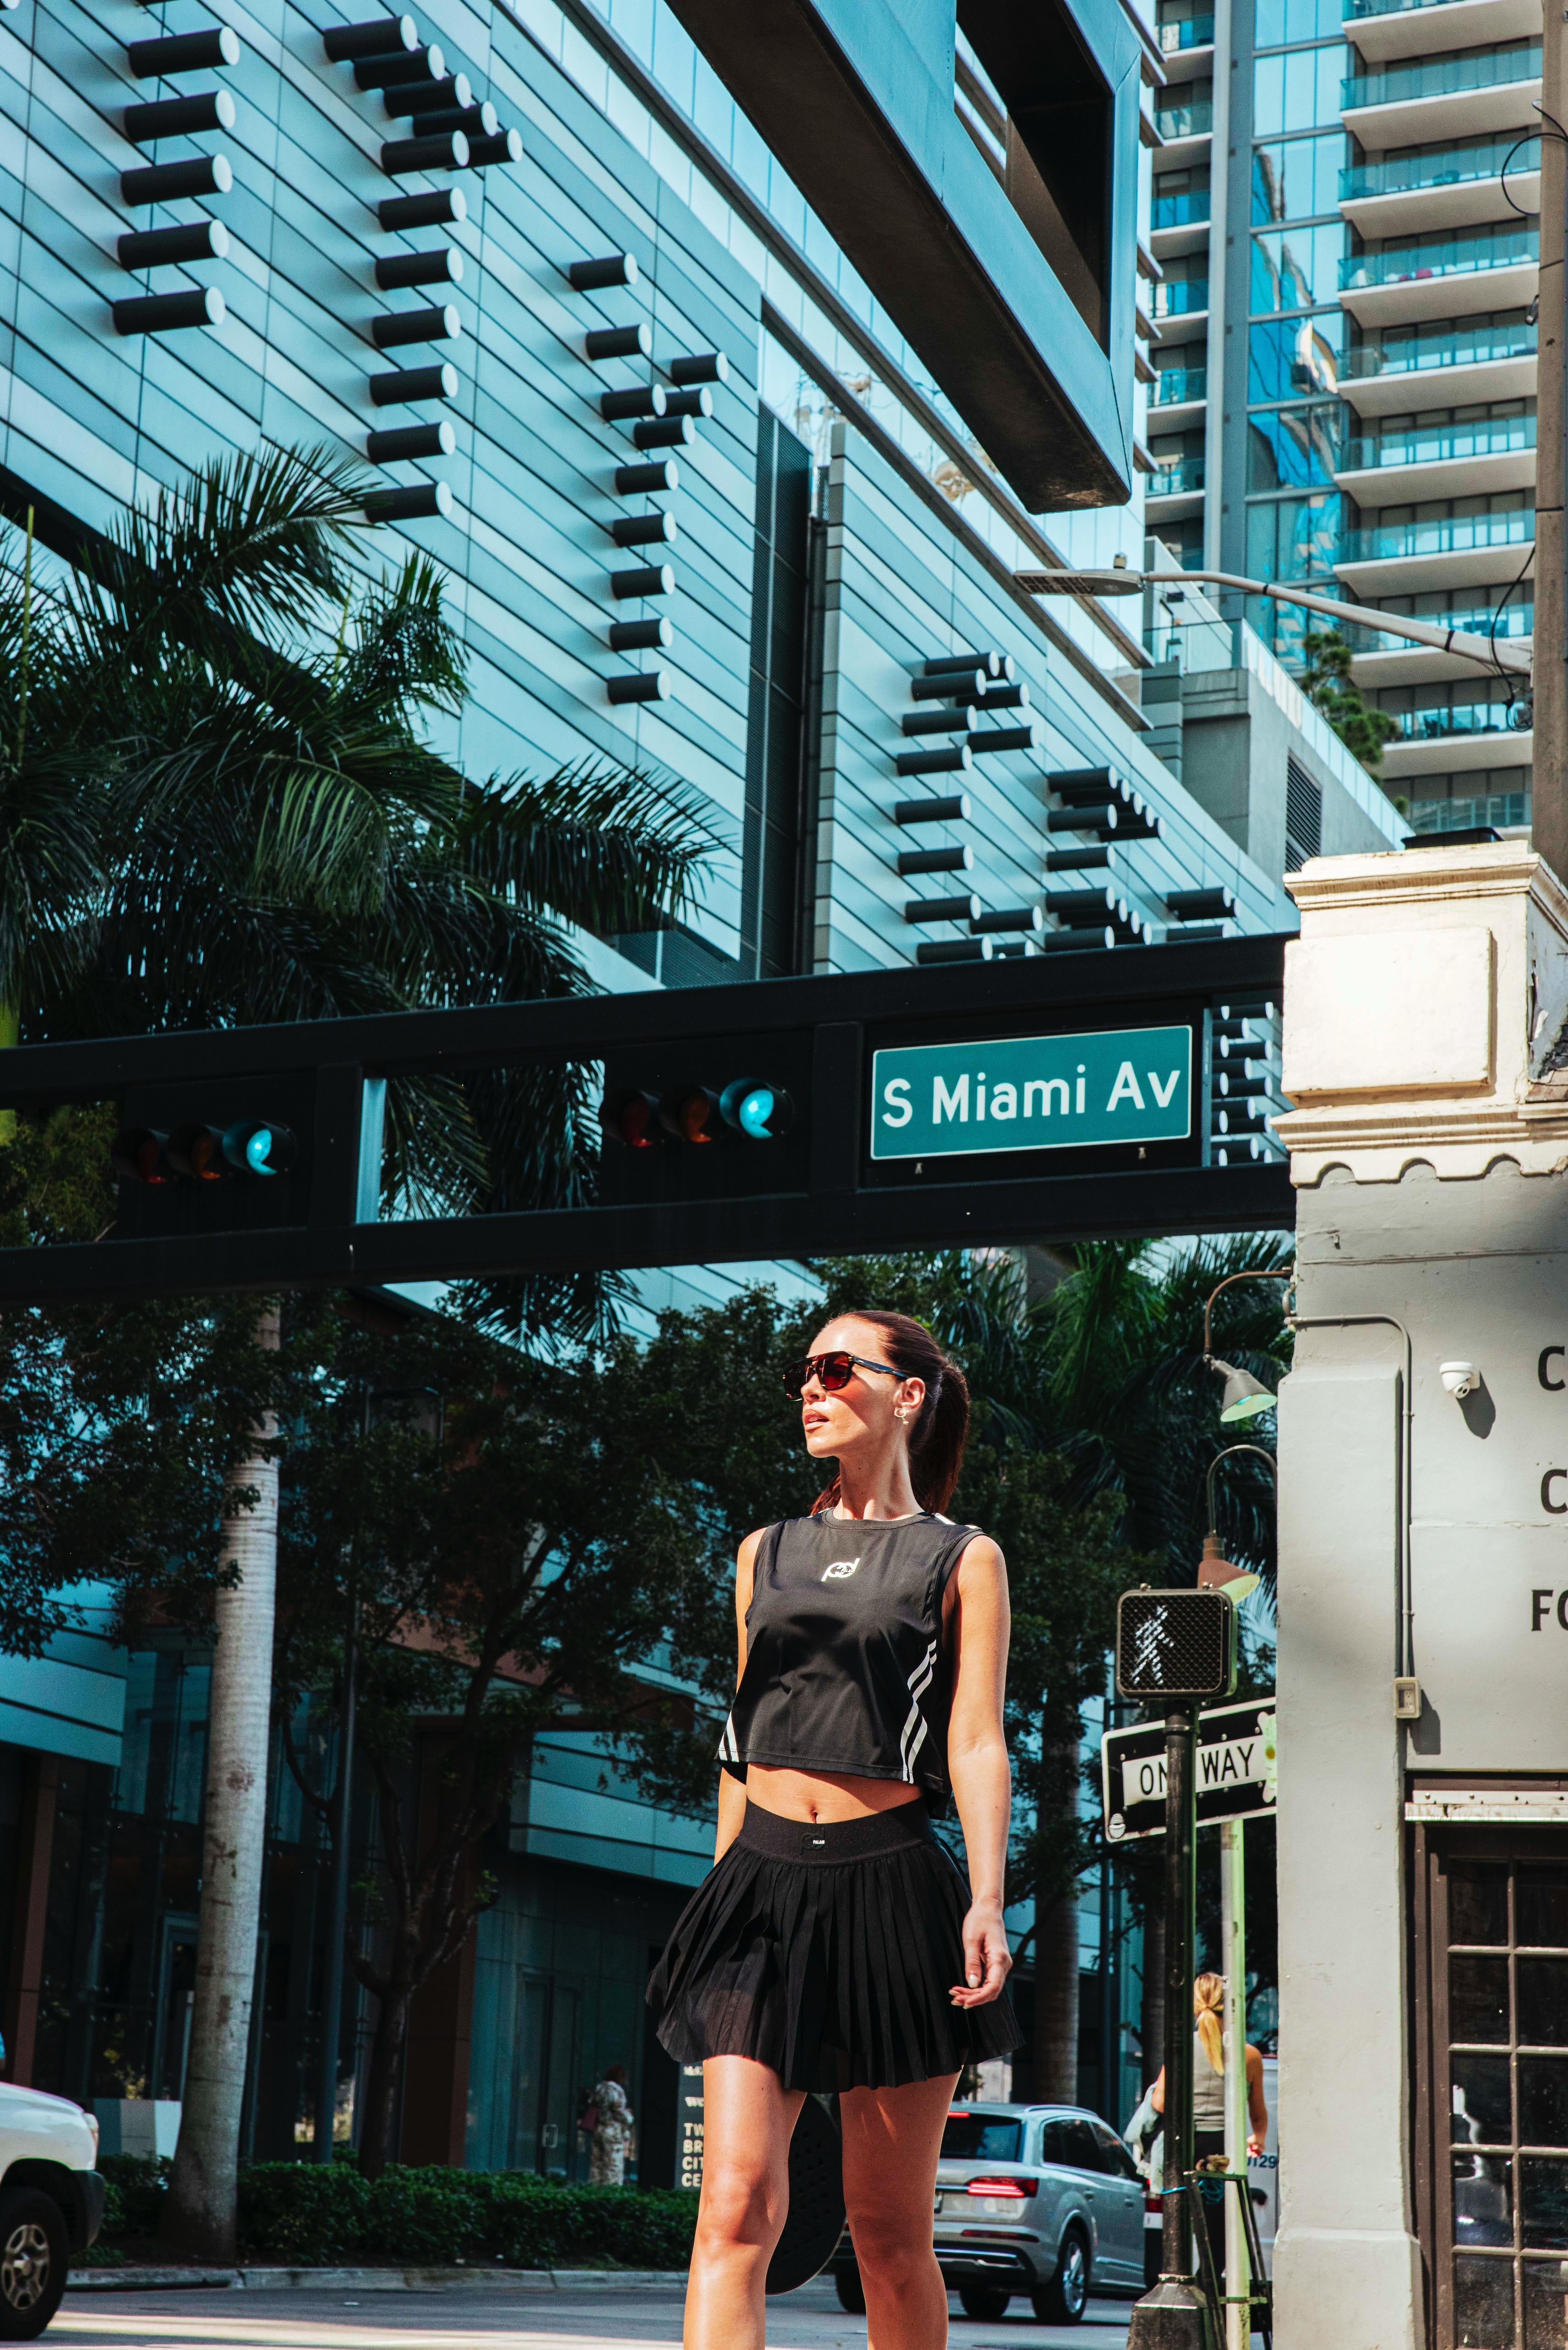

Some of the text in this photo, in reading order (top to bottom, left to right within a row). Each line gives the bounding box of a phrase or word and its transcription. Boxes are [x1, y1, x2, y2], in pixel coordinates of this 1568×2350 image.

[882, 1061, 1181, 1127] S Miami Av
[1140, 1743, 1254, 1796] ON WAY
